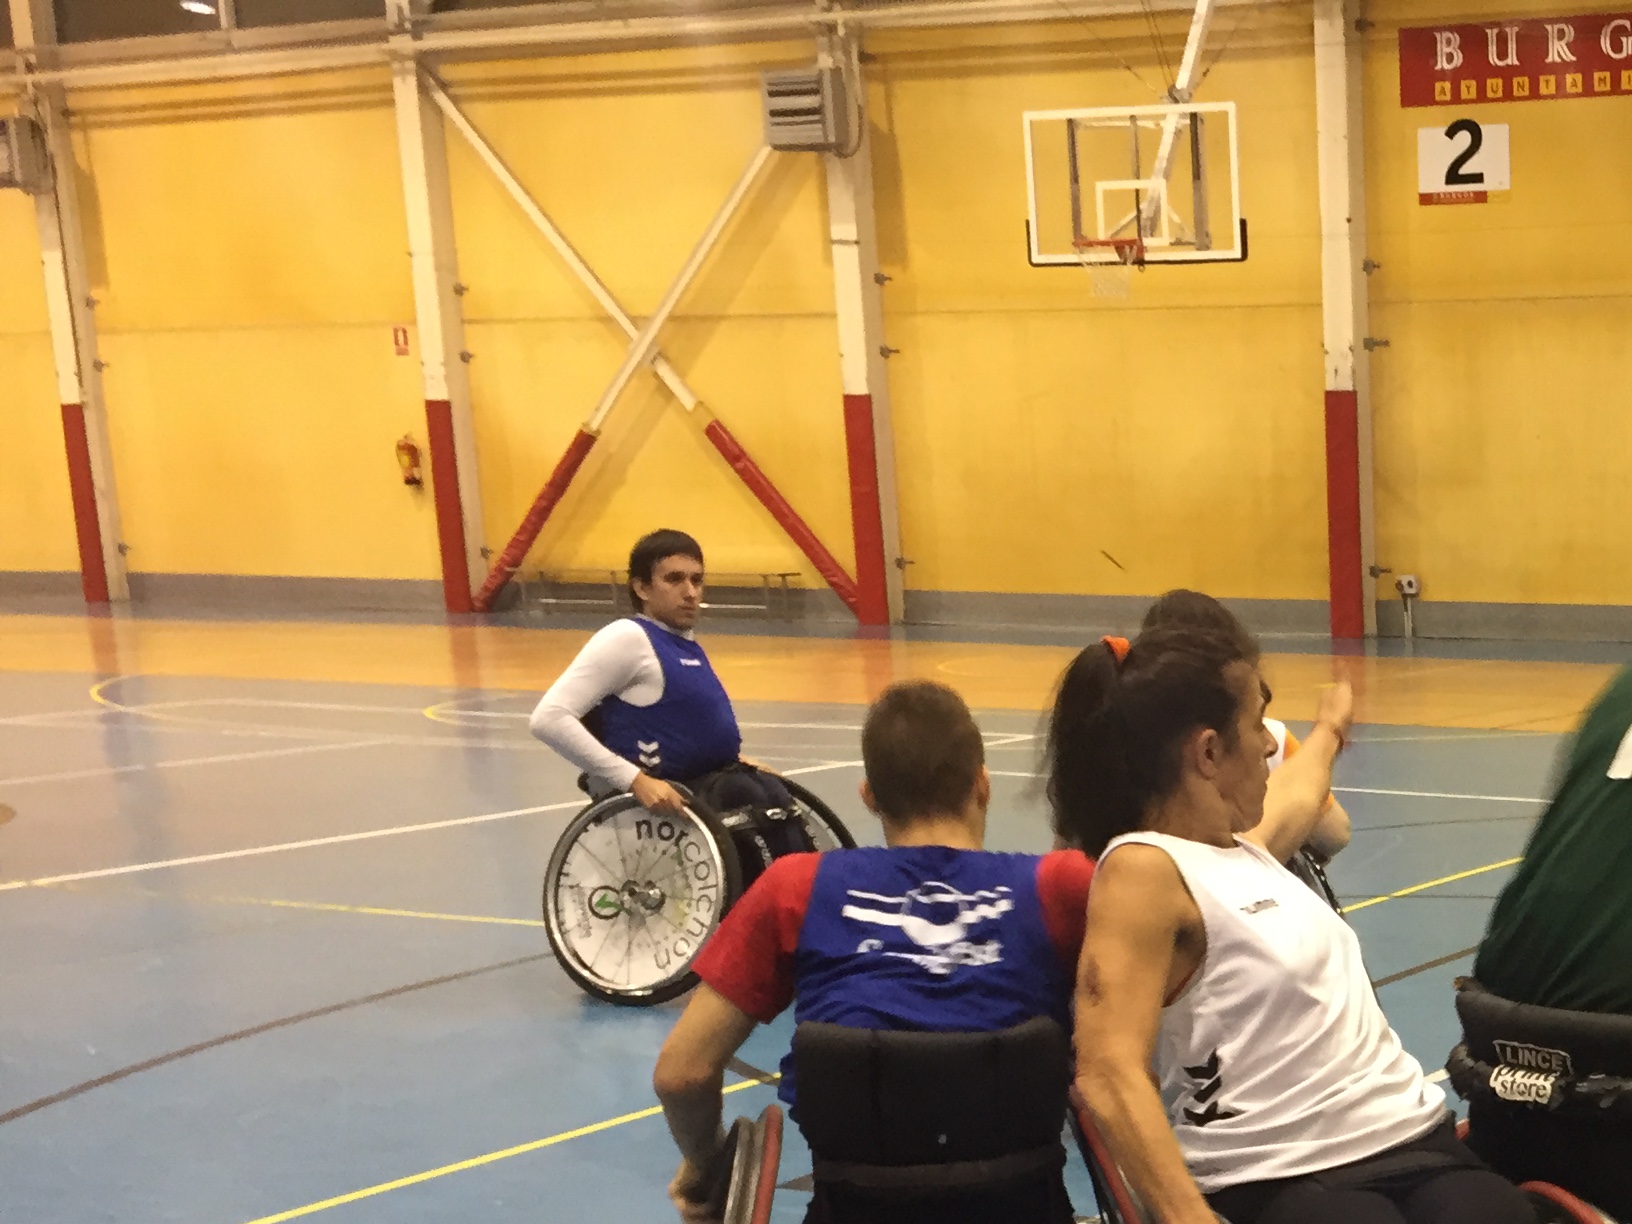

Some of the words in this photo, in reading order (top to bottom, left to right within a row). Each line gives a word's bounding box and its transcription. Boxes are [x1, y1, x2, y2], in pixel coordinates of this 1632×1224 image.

[1444, 119, 1484, 185] 2
[1506, 1046, 1563, 1073] LINCE
[1500, 1077, 1547, 1098] store
